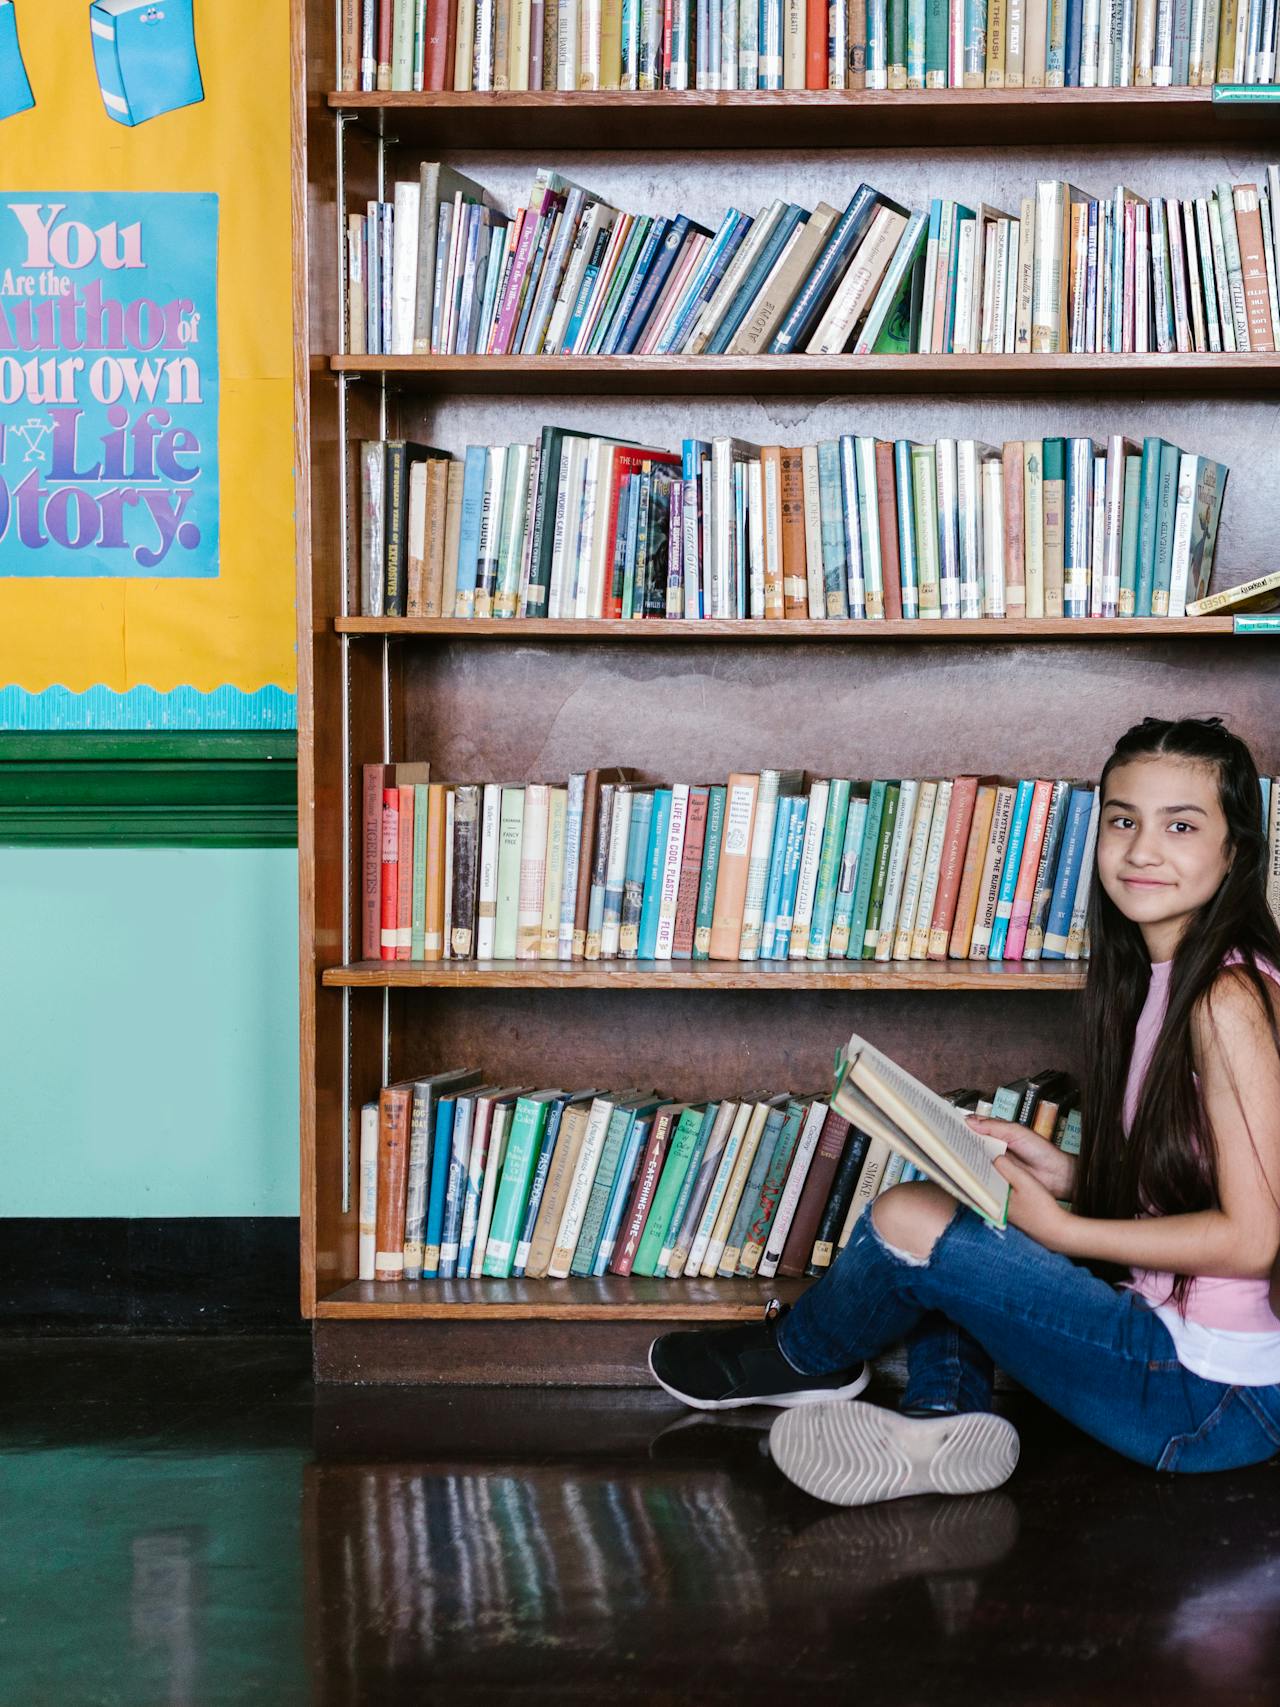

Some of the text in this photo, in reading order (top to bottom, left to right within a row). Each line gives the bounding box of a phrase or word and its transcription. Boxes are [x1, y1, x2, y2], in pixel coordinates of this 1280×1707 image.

[559, 18, 567, 37] BILL
[7, 203, 147, 270] You
[2, 269, 71, 297] Are the
[505, 224, 533, 311] The Wind in the Willows
[1021, 263, 1031, 310] Umbrella Man
[1230, 282, 1244, 313] LITTLE
[177, 313, 201, 345] of
[89, 356, 204, 404] own
[45, 404, 201, 483] Life
[808, 465, 817, 527] KATIE JOHN
[392, 533, 398, 542] OF
[554, 491, 565, 553] WORDS CAN TELL
[1159, 521, 1168, 563] MANEATER
[1175, 512, 1187, 580] Caddie Woodlawn
[387, 544, 396, 595] EXPLOSIVES
[1198, 593, 1226, 611] USED
[670, 802, 683, 818] LIFE
[1001, 794, 1011, 808] THE
[669, 822, 681, 833] ON
[706, 795, 720, 870] HAYSEED SUMMER
[795, 821, 803, 834] The
[995, 809, 1008, 845] MYSTERY
[1031, 784, 1061, 902] The Mysterious Buckskin
[366, 820, 377, 894] TIGER EYES
[666, 844, 679, 866] COOL
[791, 851, 799, 869] Mom
[804, 838, 814, 864] WHITE
[991, 856, 1001, 872] THE
[994, 845, 1003, 855] OF
[663, 868, 677, 901] PLASTIC
[987, 874, 999, 902] BURIED
[659, 921, 672, 940] FLOE
[546, 1109, 557, 1135] Coleman
[655, 1116, 668, 1140] COLLINS
[528, 1152, 549, 1206] FAST EDDIE
[858, 1161, 878, 1198] SMOKE
[629, 1160, 656, 1236] CATCHING FIRE
